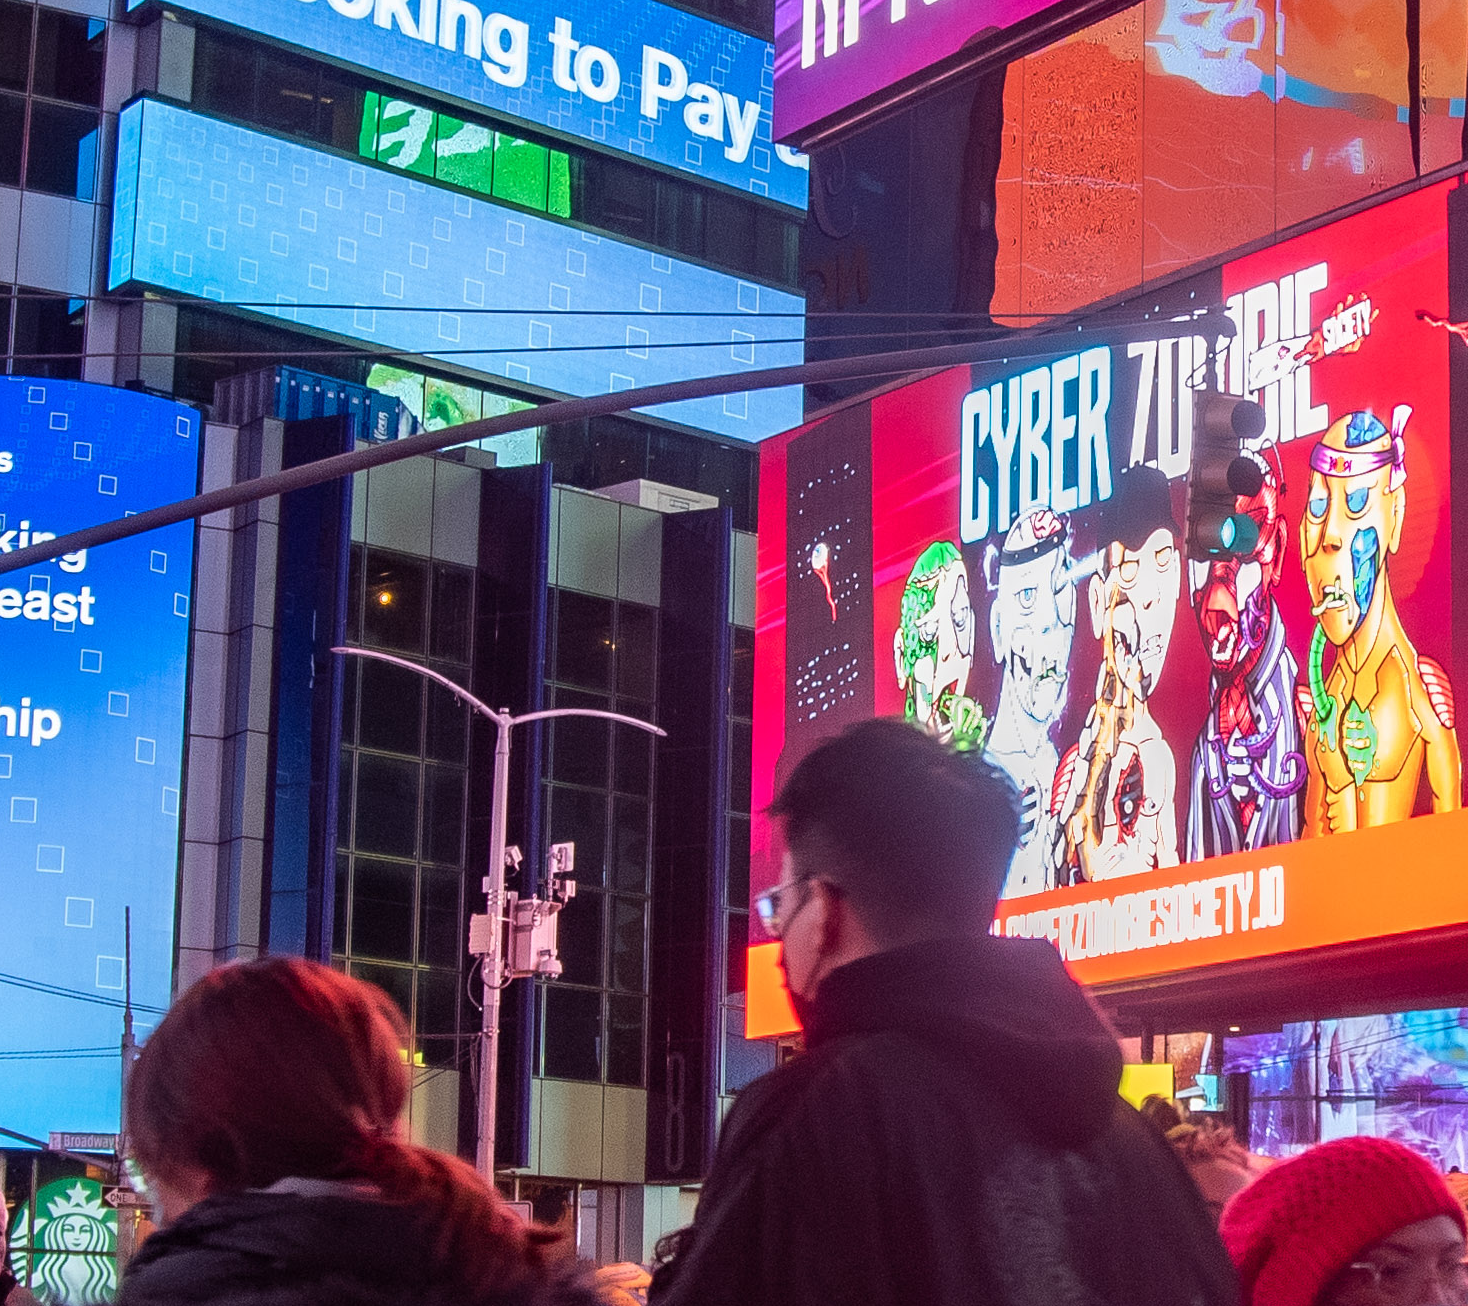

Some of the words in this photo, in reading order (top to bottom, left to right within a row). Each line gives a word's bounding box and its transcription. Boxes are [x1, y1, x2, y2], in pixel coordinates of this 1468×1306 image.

[549, 16, 621, 104] to
[641, 44, 759, 157] Pay
[1323, 298, 1372, 355] SOCIETY
[960, 345, 1112, 545] CYBER
[64, 1135, 114, 1149] Broadway
[110, 1193, 127, 1203] ONE
